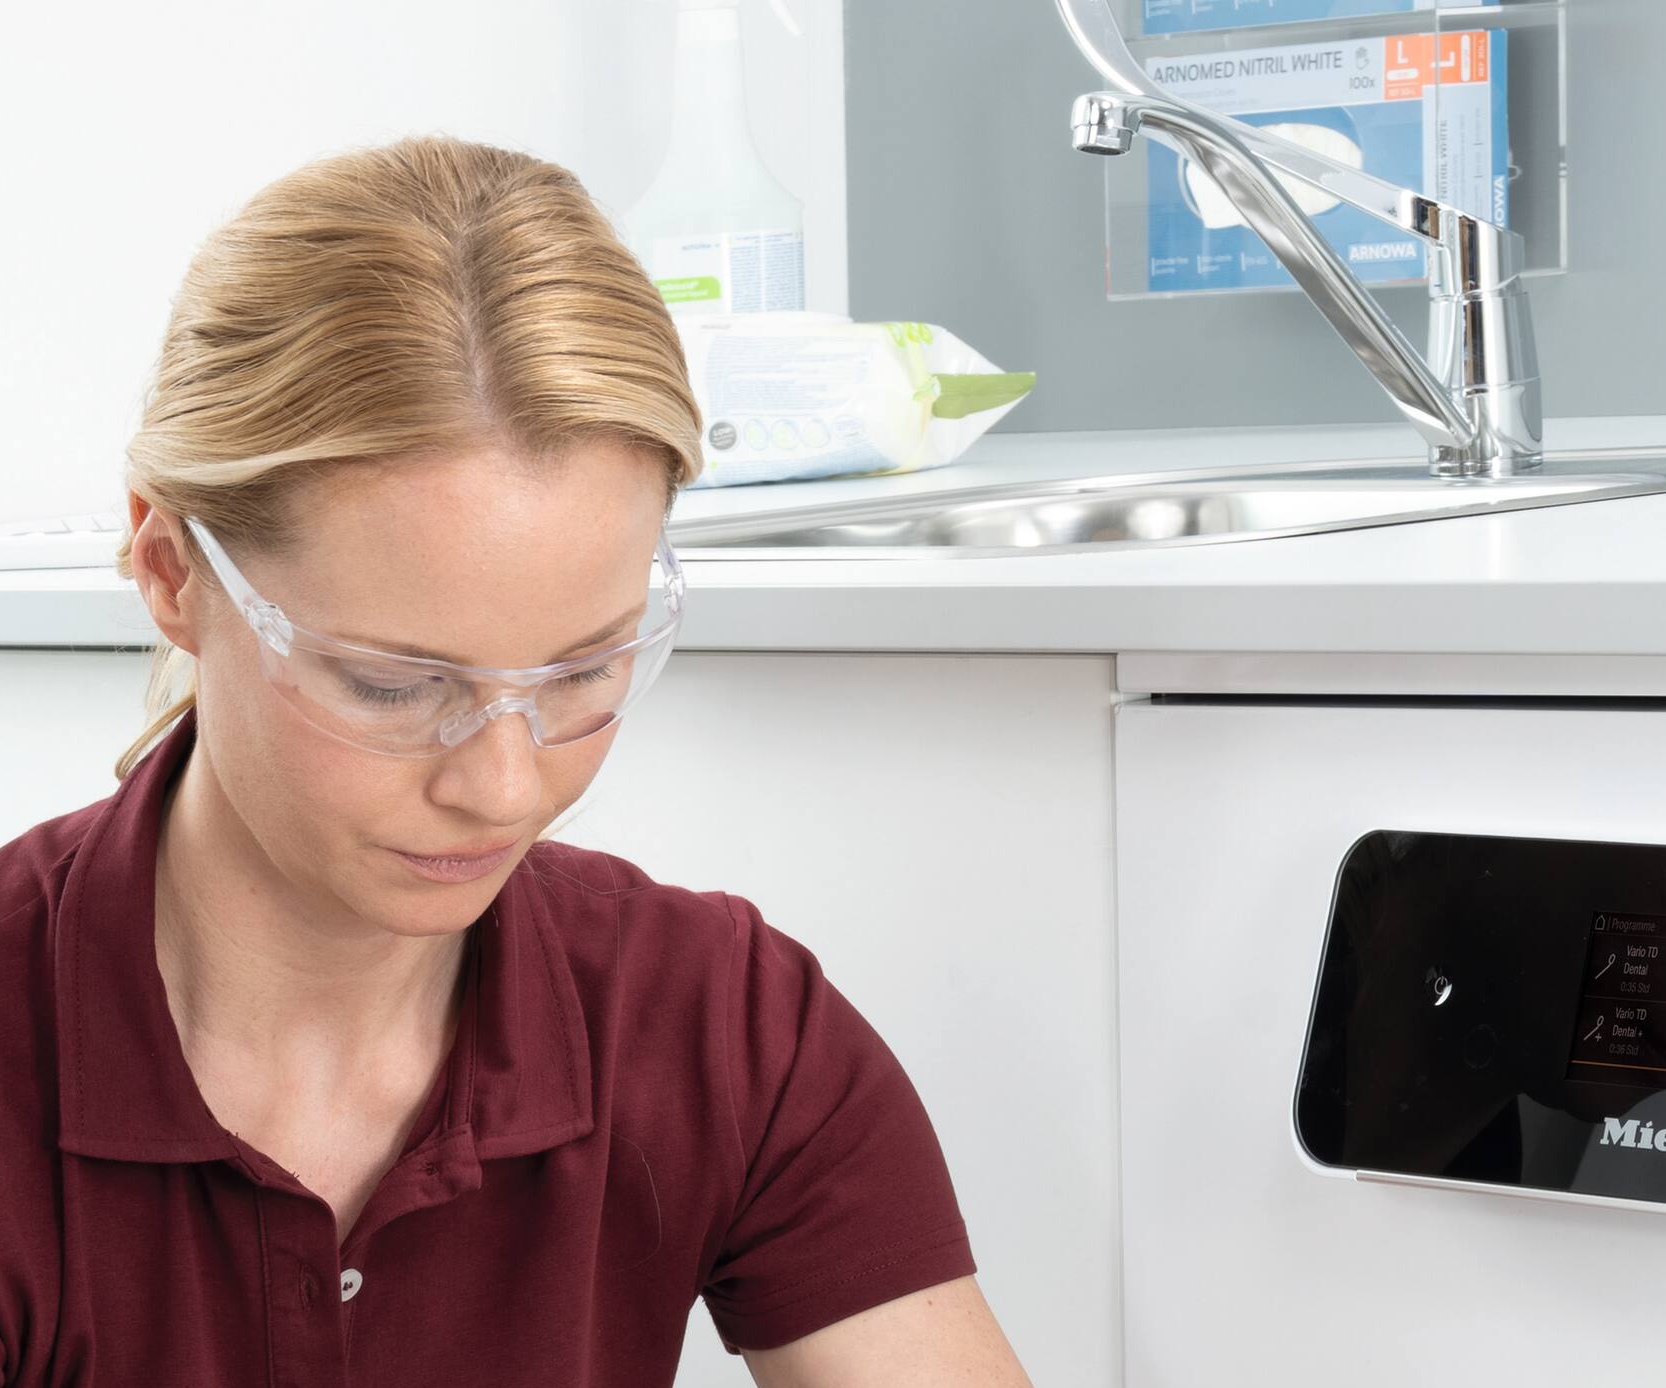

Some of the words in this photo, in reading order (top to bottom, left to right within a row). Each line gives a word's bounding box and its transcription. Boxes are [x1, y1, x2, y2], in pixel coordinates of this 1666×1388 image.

[1397, 41, 1408, 64] L
[1153, 61, 1235, 85] ARNOMED
[1239, 55, 1287, 77] NITRIL
[1291, 50, 1342, 72] WHITE
[1349, 76, 1375, 90] 100x
[1349, 243, 1416, 262] ARNOWA
[1611, 919, 1656, 933] Programme
[1626, 945, 1646, 958] Vario
[1647, 946, 1658, 959] TD
[1623, 963, 1648, 976] Dental
[1638, 982, 1650, 993] Std
[1615, 1007, 1634, 1020] Vario
[1635, 1008, 1647, 1020] TD
[1612, 1025, 1636, 1037] Dental
